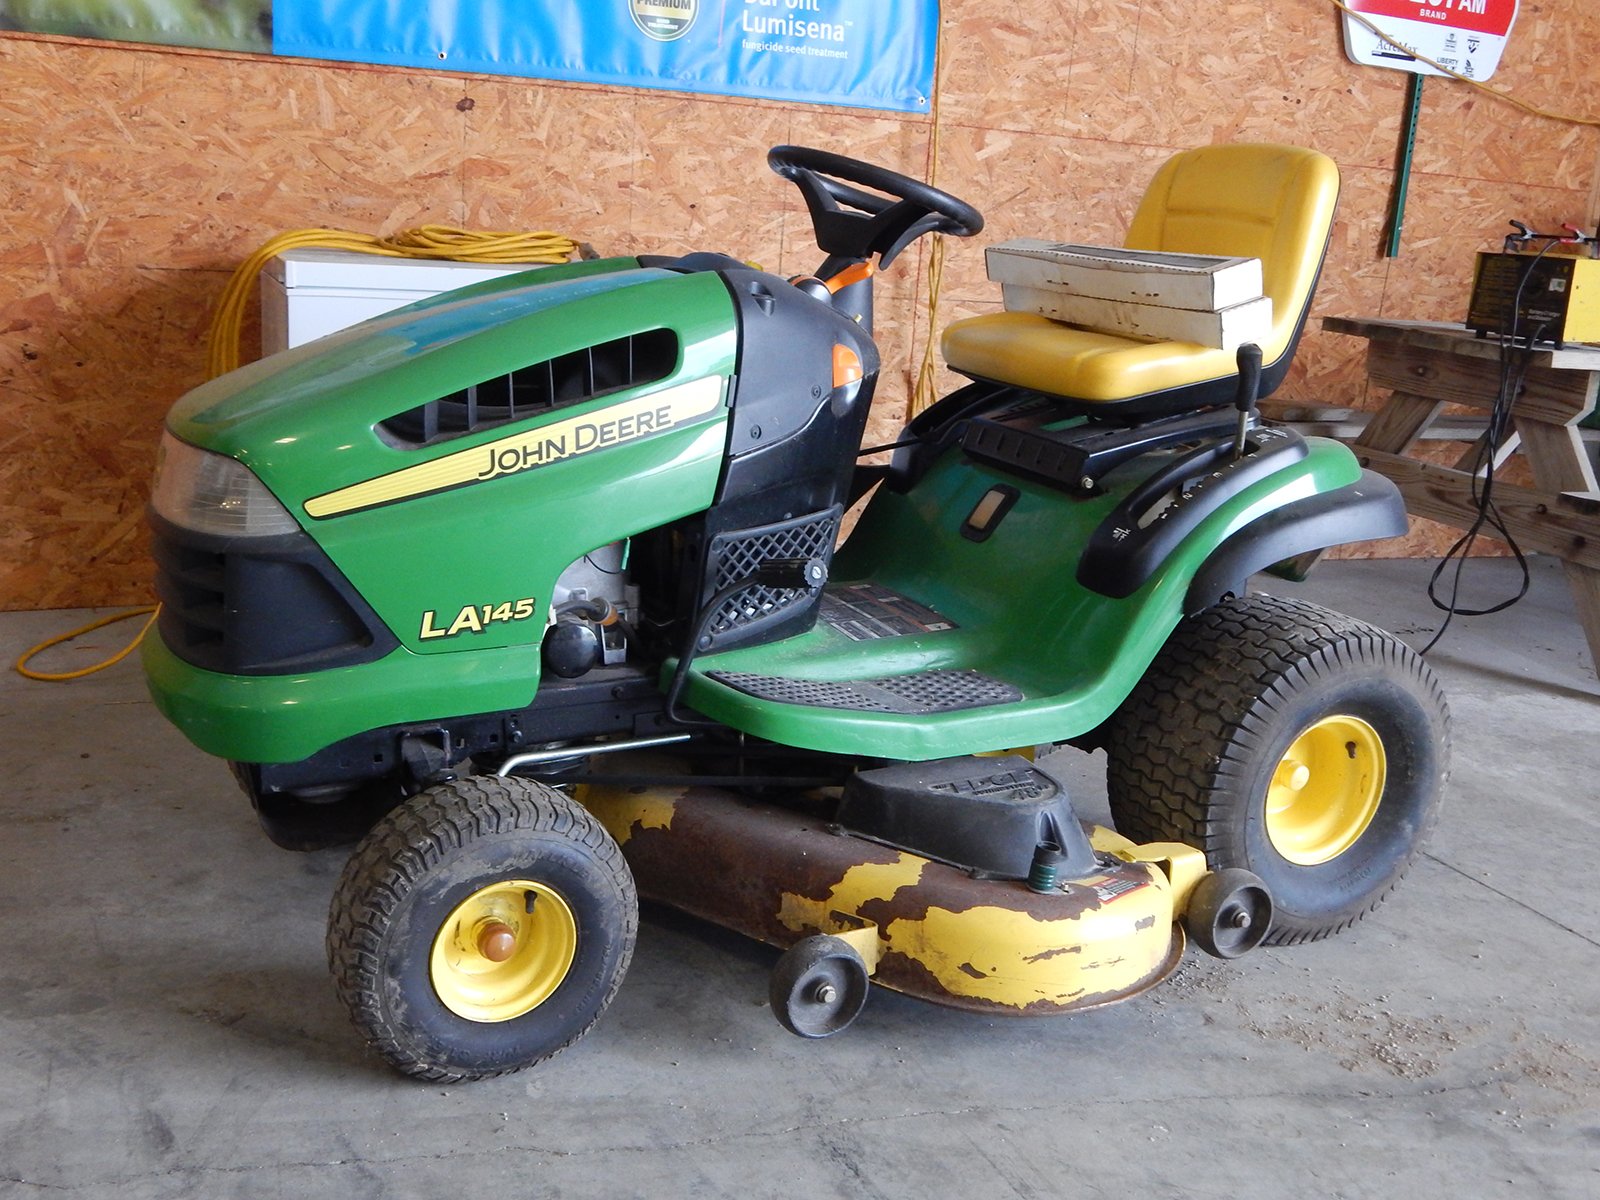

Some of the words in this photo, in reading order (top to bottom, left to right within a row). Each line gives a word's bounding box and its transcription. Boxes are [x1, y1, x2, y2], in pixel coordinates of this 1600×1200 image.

[1419, 8, 1447, 20] BRAND
[742, 39, 783, 53] fungicide
[785, 44, 806, 55] seed
[807, 46, 848, 59] treatment
[1436, 56, 1459, 66] LIBERTY
[478, 434, 566, 477] JOHN
[574, 404, 672, 451] DEERE
[420, 598, 535, 640] LA145
